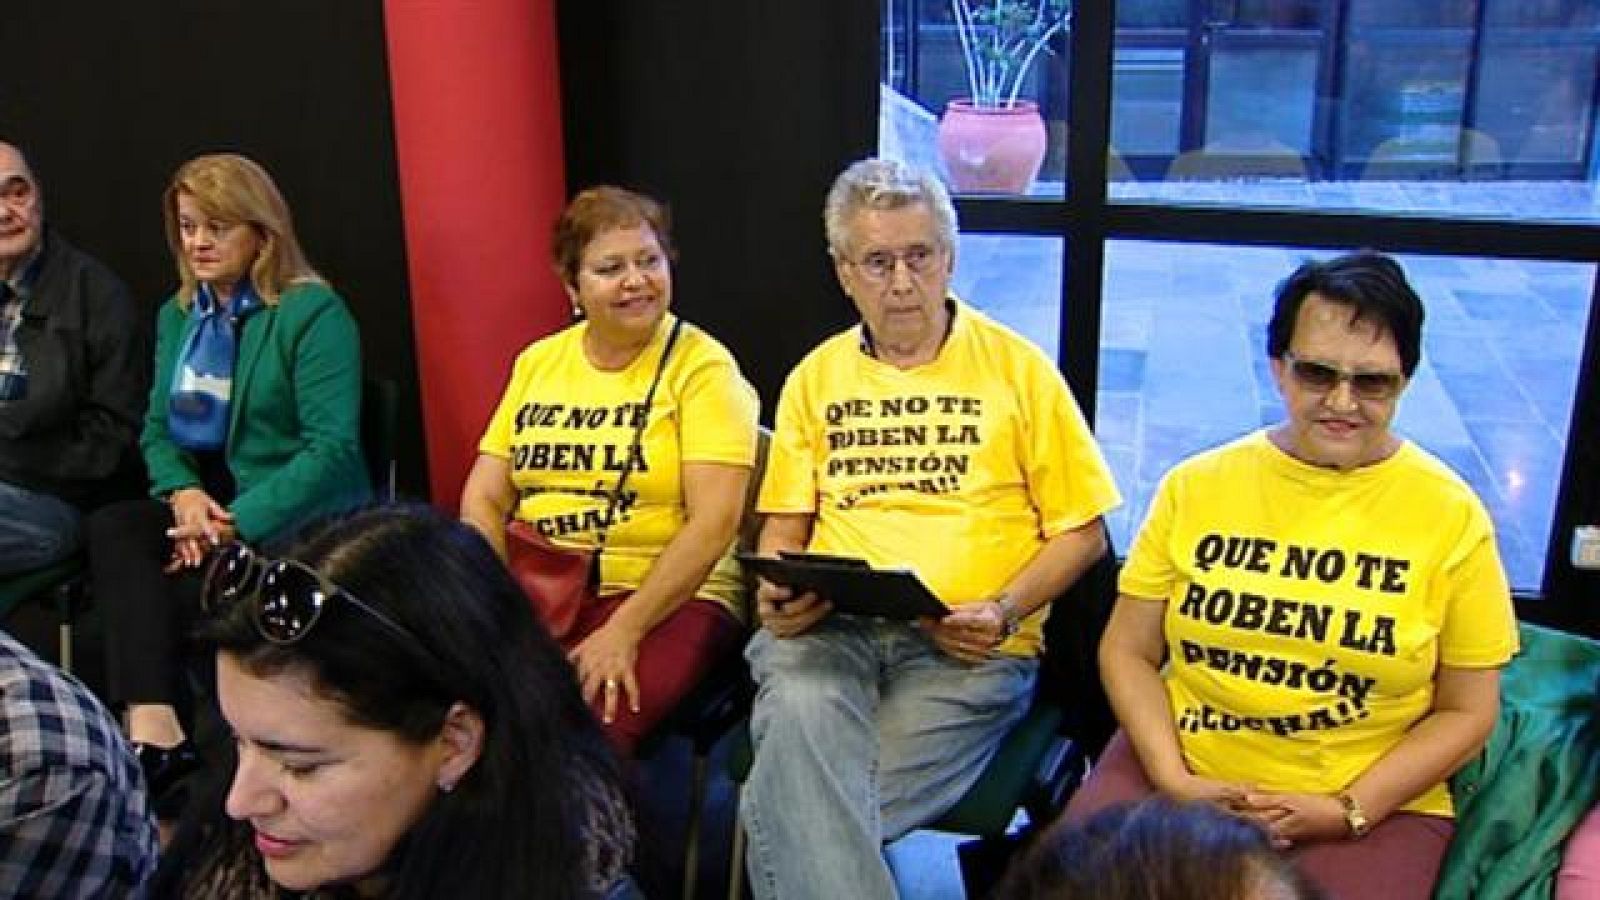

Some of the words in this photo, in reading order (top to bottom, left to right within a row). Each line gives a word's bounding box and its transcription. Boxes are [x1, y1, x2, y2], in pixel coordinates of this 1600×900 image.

[563, 407, 608, 430] NO
[880, 397, 929, 417] NO
[936, 395, 982, 416] TE
[936, 424, 981, 446] LA
[603, 443, 649, 472] LA
[827, 450, 968, 477] PENSIÓN
[1194, 533, 1277, 572] QUE
[1279, 544, 1347, 583] NO
[1354, 551, 1411, 593] TE
[1179, 582, 1333, 643] ROBEN
[1339, 609, 1397, 656] LA
[1179, 639, 1377, 711] PENSIÓN
